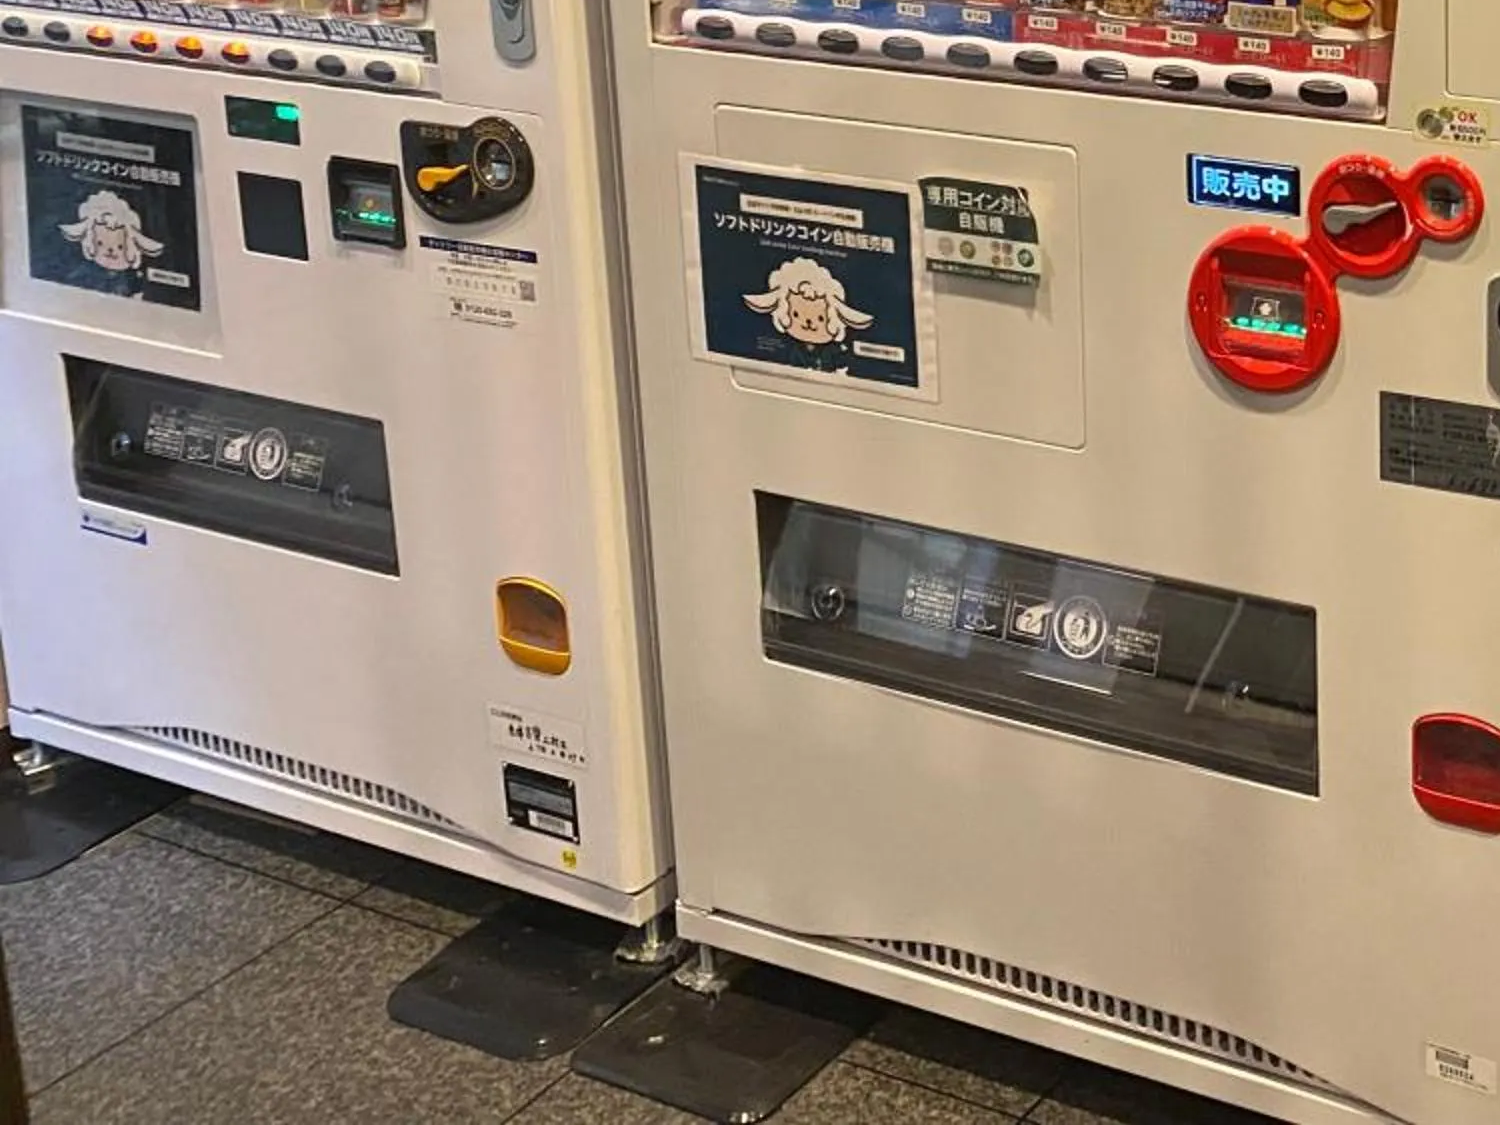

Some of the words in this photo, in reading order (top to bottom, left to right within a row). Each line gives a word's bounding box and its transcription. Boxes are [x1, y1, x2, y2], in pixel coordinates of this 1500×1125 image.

[1457, 110, 1478, 124] OK
[1200, 166, 1291, 204] 販売中
[713, 210, 897, 255] ソフトドリンクコイン自動販売機
